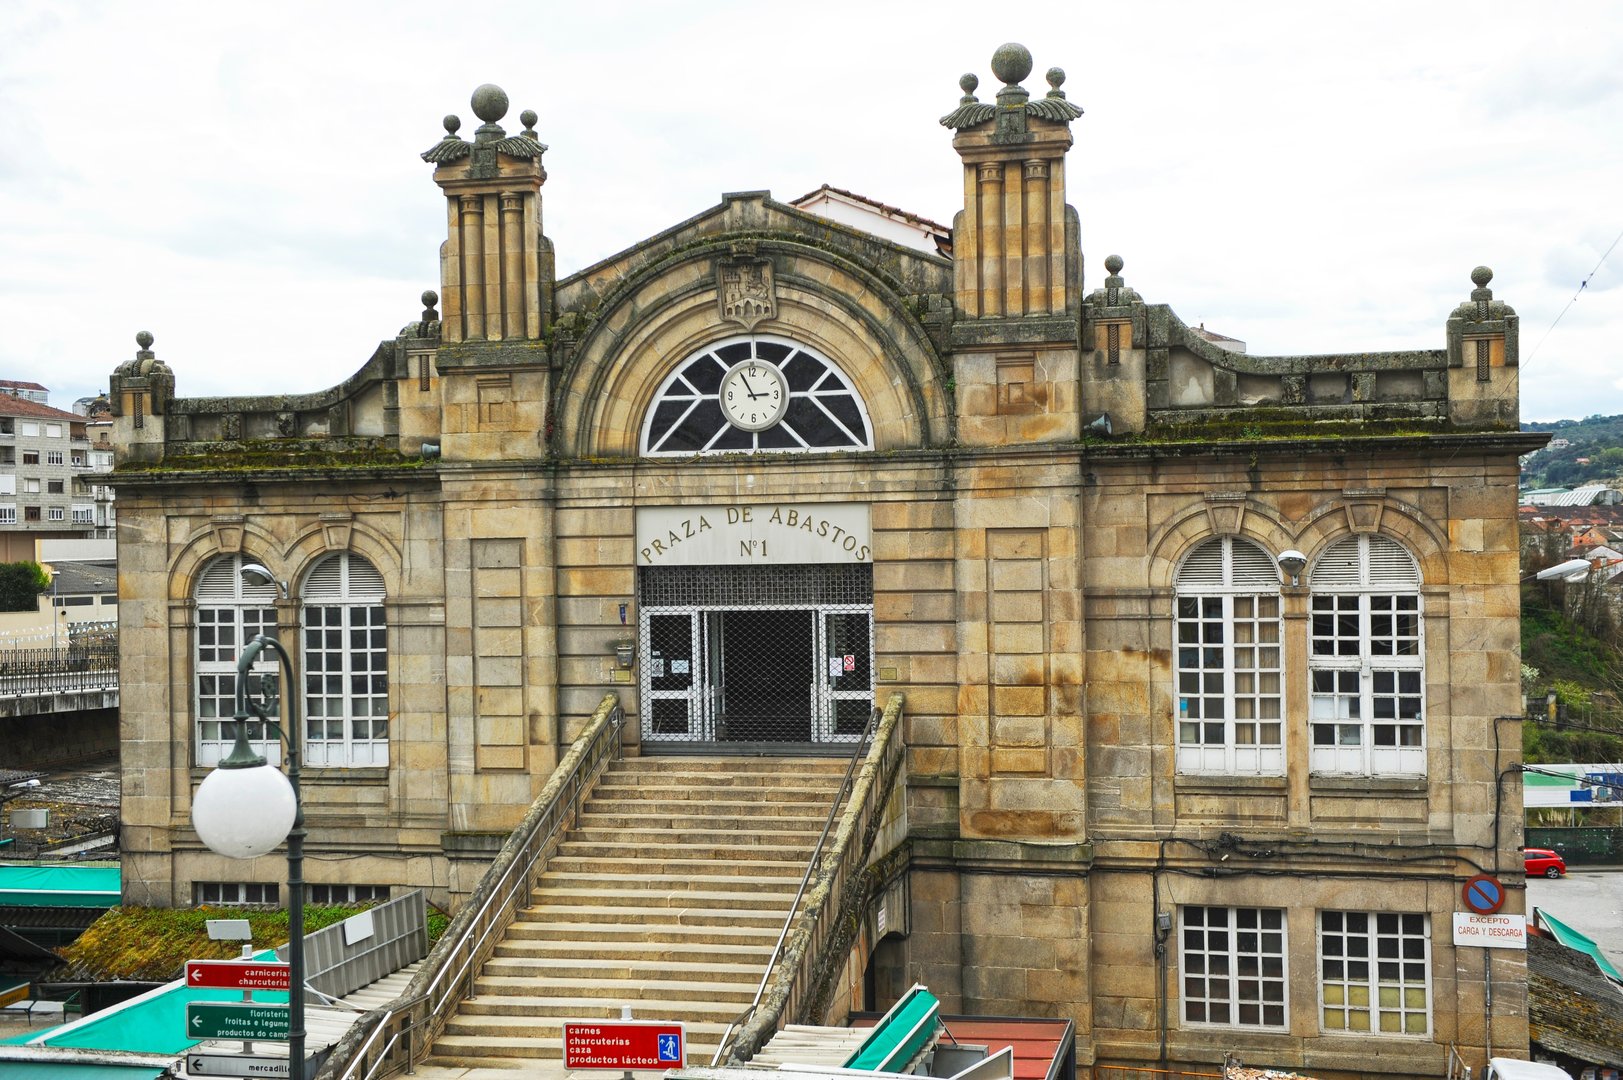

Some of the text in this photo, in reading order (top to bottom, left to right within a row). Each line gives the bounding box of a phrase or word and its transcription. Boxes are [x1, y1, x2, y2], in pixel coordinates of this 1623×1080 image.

[748, 367, 757, 378] 12
[727, 391, 734, 401] 9
[773, 390, 779, 400] 3
[751, 413, 757, 423] 6
[640, 506, 871, 564] PRAZA DE ABASTOS
[1469, 916, 1510, 925] EXCEPTO
[1458, 926, 1523, 937] CARGA Y DESCARGA
[225, 1017, 251, 1026] froitas
[261, 1019, 289, 1028] legume
[217, 1029, 255, 1037] productos
[268, 1031, 289, 1039] camp
[569, 1027, 601, 1035] carnes
[569, 1055, 659, 1065] productos lácteos
